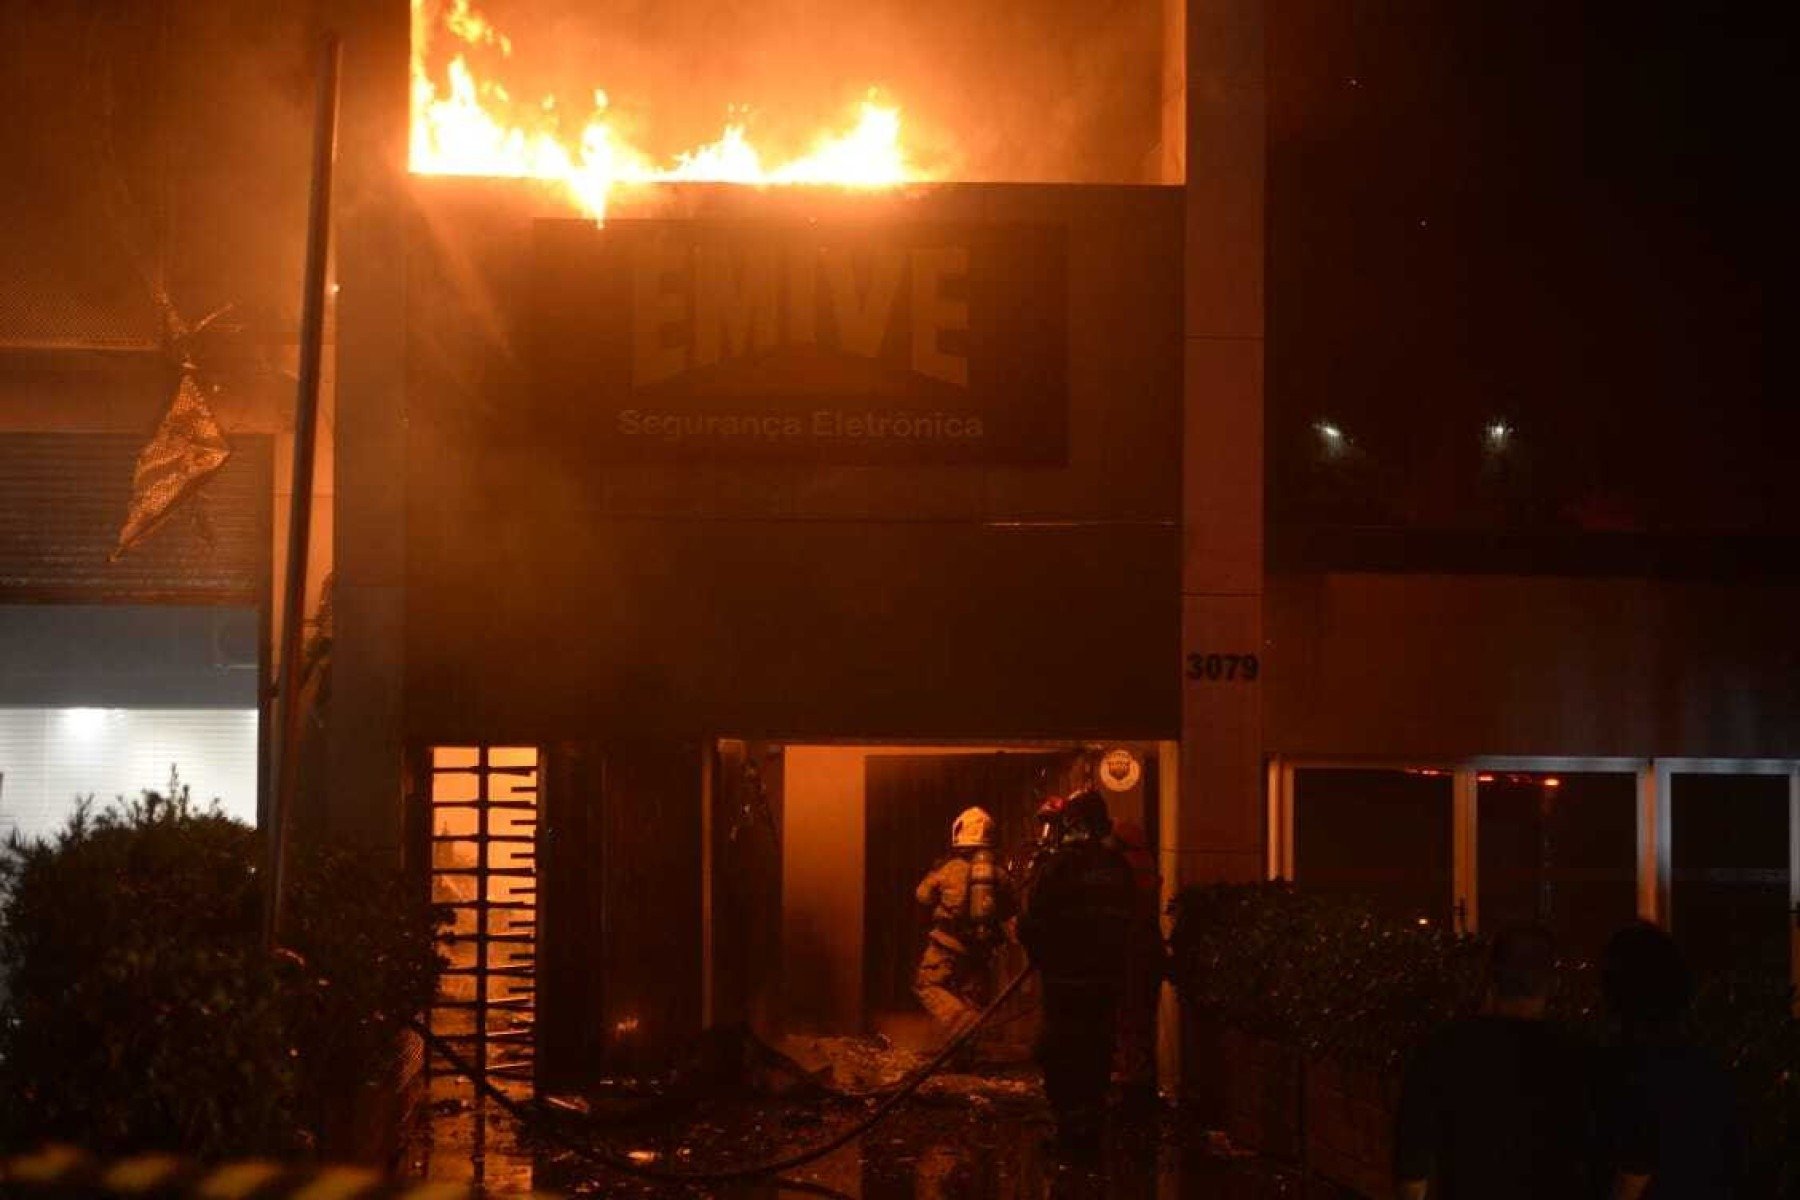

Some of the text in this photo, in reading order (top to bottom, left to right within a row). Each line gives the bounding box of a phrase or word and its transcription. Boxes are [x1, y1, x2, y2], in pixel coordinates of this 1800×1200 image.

[632, 243, 971, 388] EMIVE
[617, 407, 985, 442] Segurança Eletrônica
[1186, 653, 1258, 681] 3079
